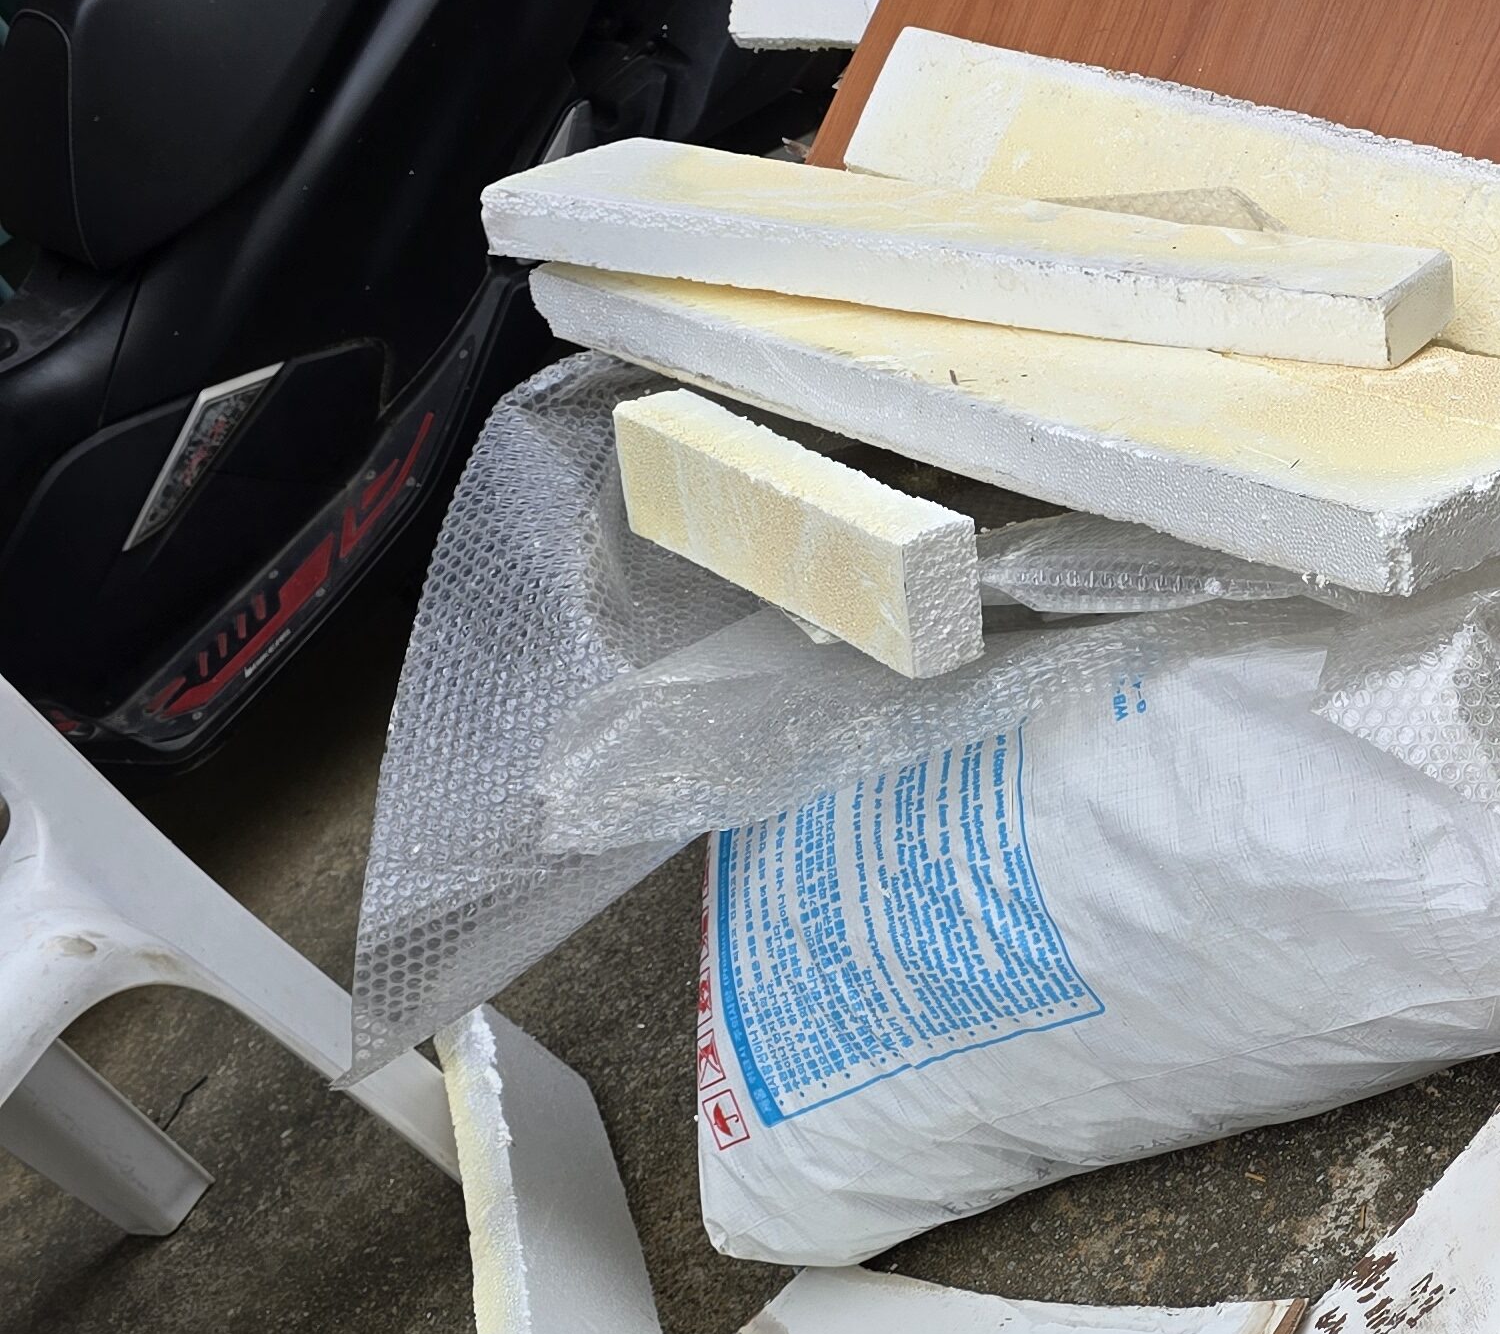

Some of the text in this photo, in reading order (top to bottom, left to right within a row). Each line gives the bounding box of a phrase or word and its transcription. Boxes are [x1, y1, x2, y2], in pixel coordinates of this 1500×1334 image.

[854, 832, 864, 859] store
[872, 813, 885, 860] moisture
[856, 862, 866, 882] and
[858, 884, 868, 902] fire
[895, 914, 915, 958] product
